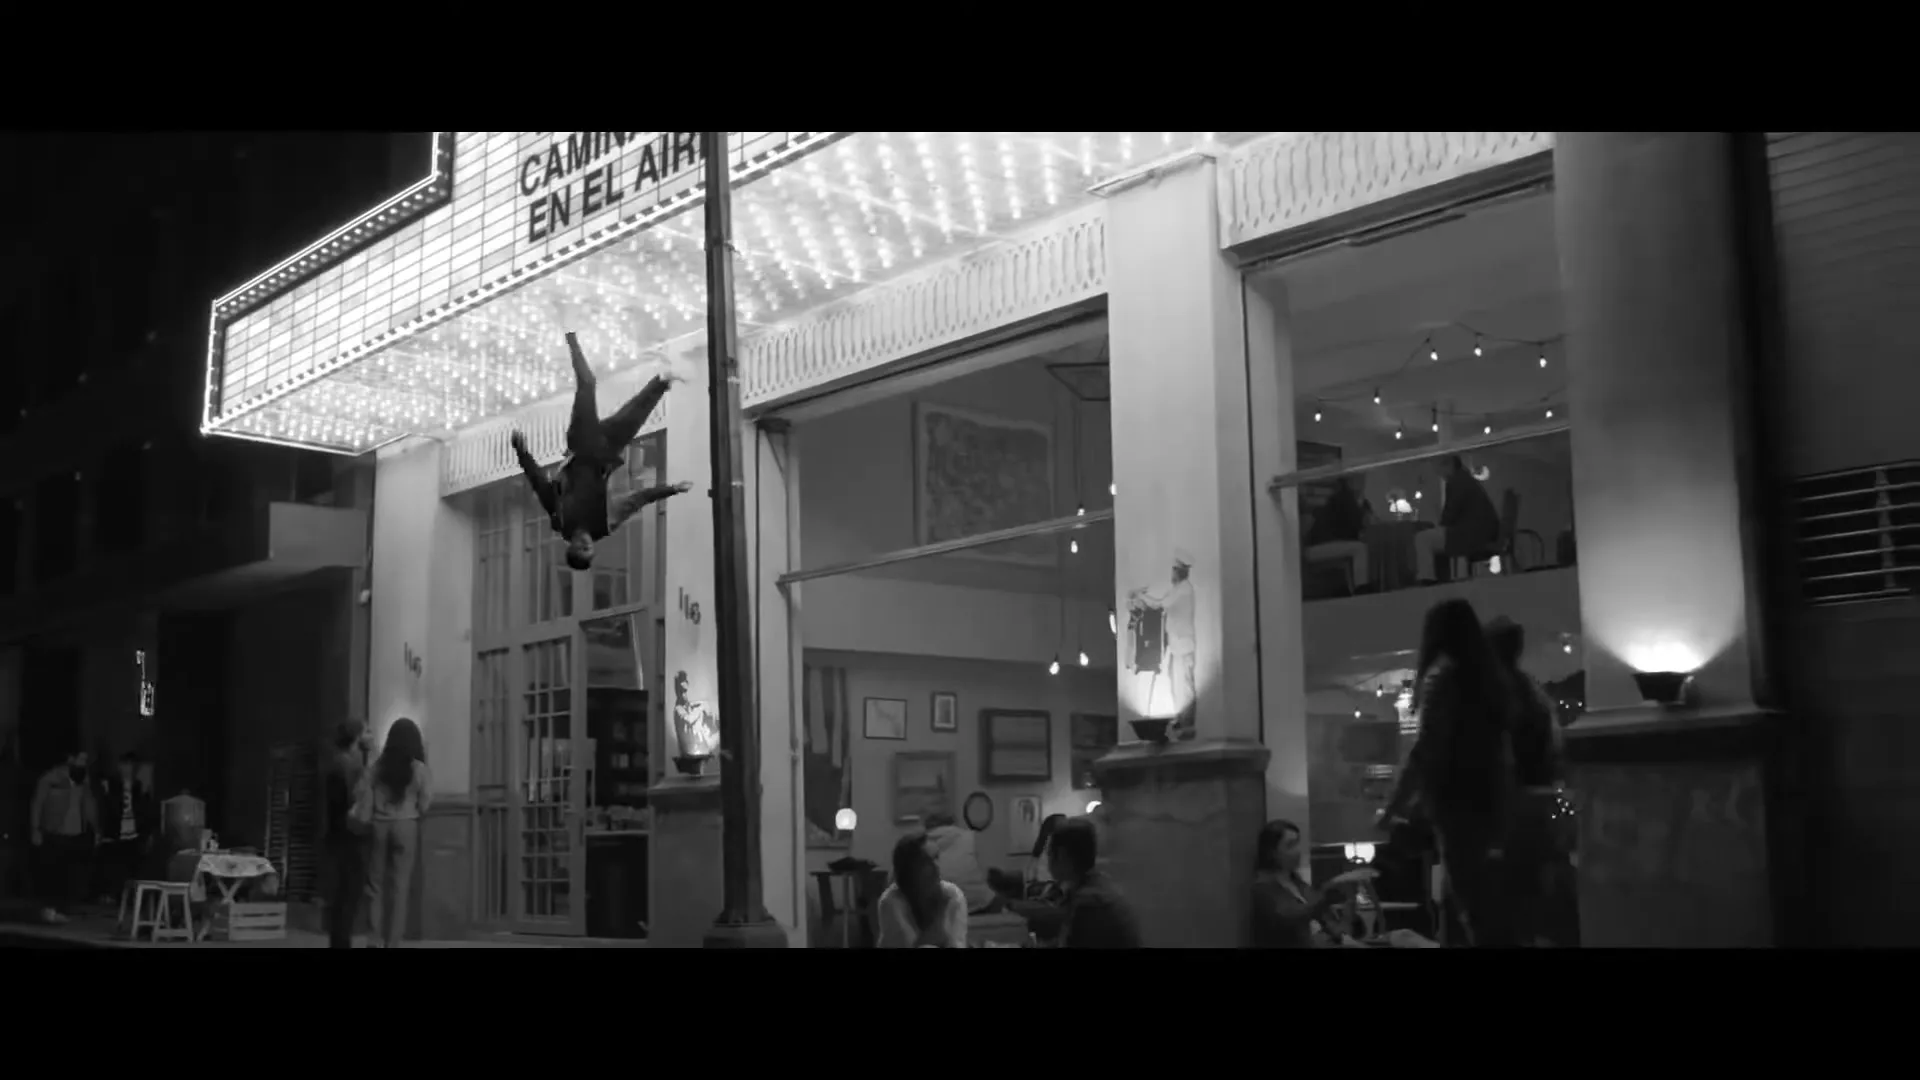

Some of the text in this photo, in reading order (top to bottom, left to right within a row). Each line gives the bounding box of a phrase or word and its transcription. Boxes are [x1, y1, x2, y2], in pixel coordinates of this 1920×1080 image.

[520, 132, 636, 196] CAMIN
[529, 132, 707, 243] EN EL AIR
